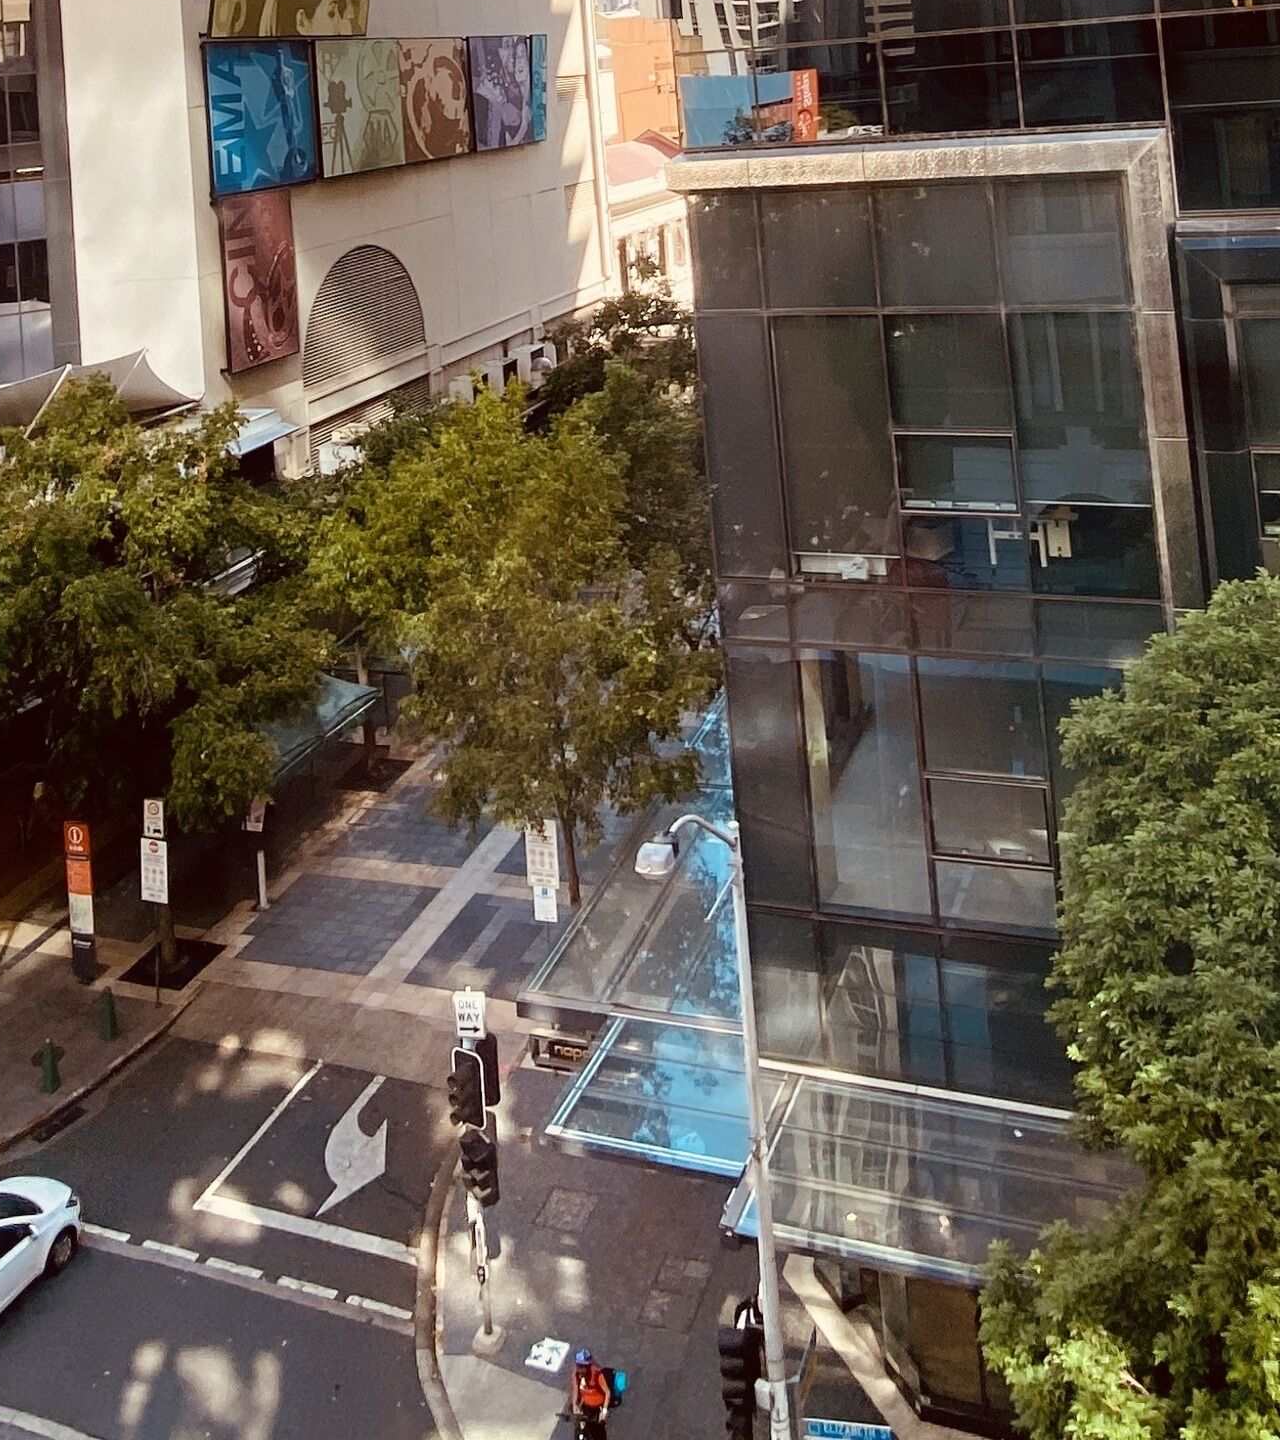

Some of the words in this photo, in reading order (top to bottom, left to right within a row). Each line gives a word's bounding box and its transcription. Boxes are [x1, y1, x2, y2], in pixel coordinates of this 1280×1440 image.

[458, 999, 479, 1010] ONE
[458, 1012, 480, 1023] WAY
[823, 1421, 876, 1439] ELIZABETH
